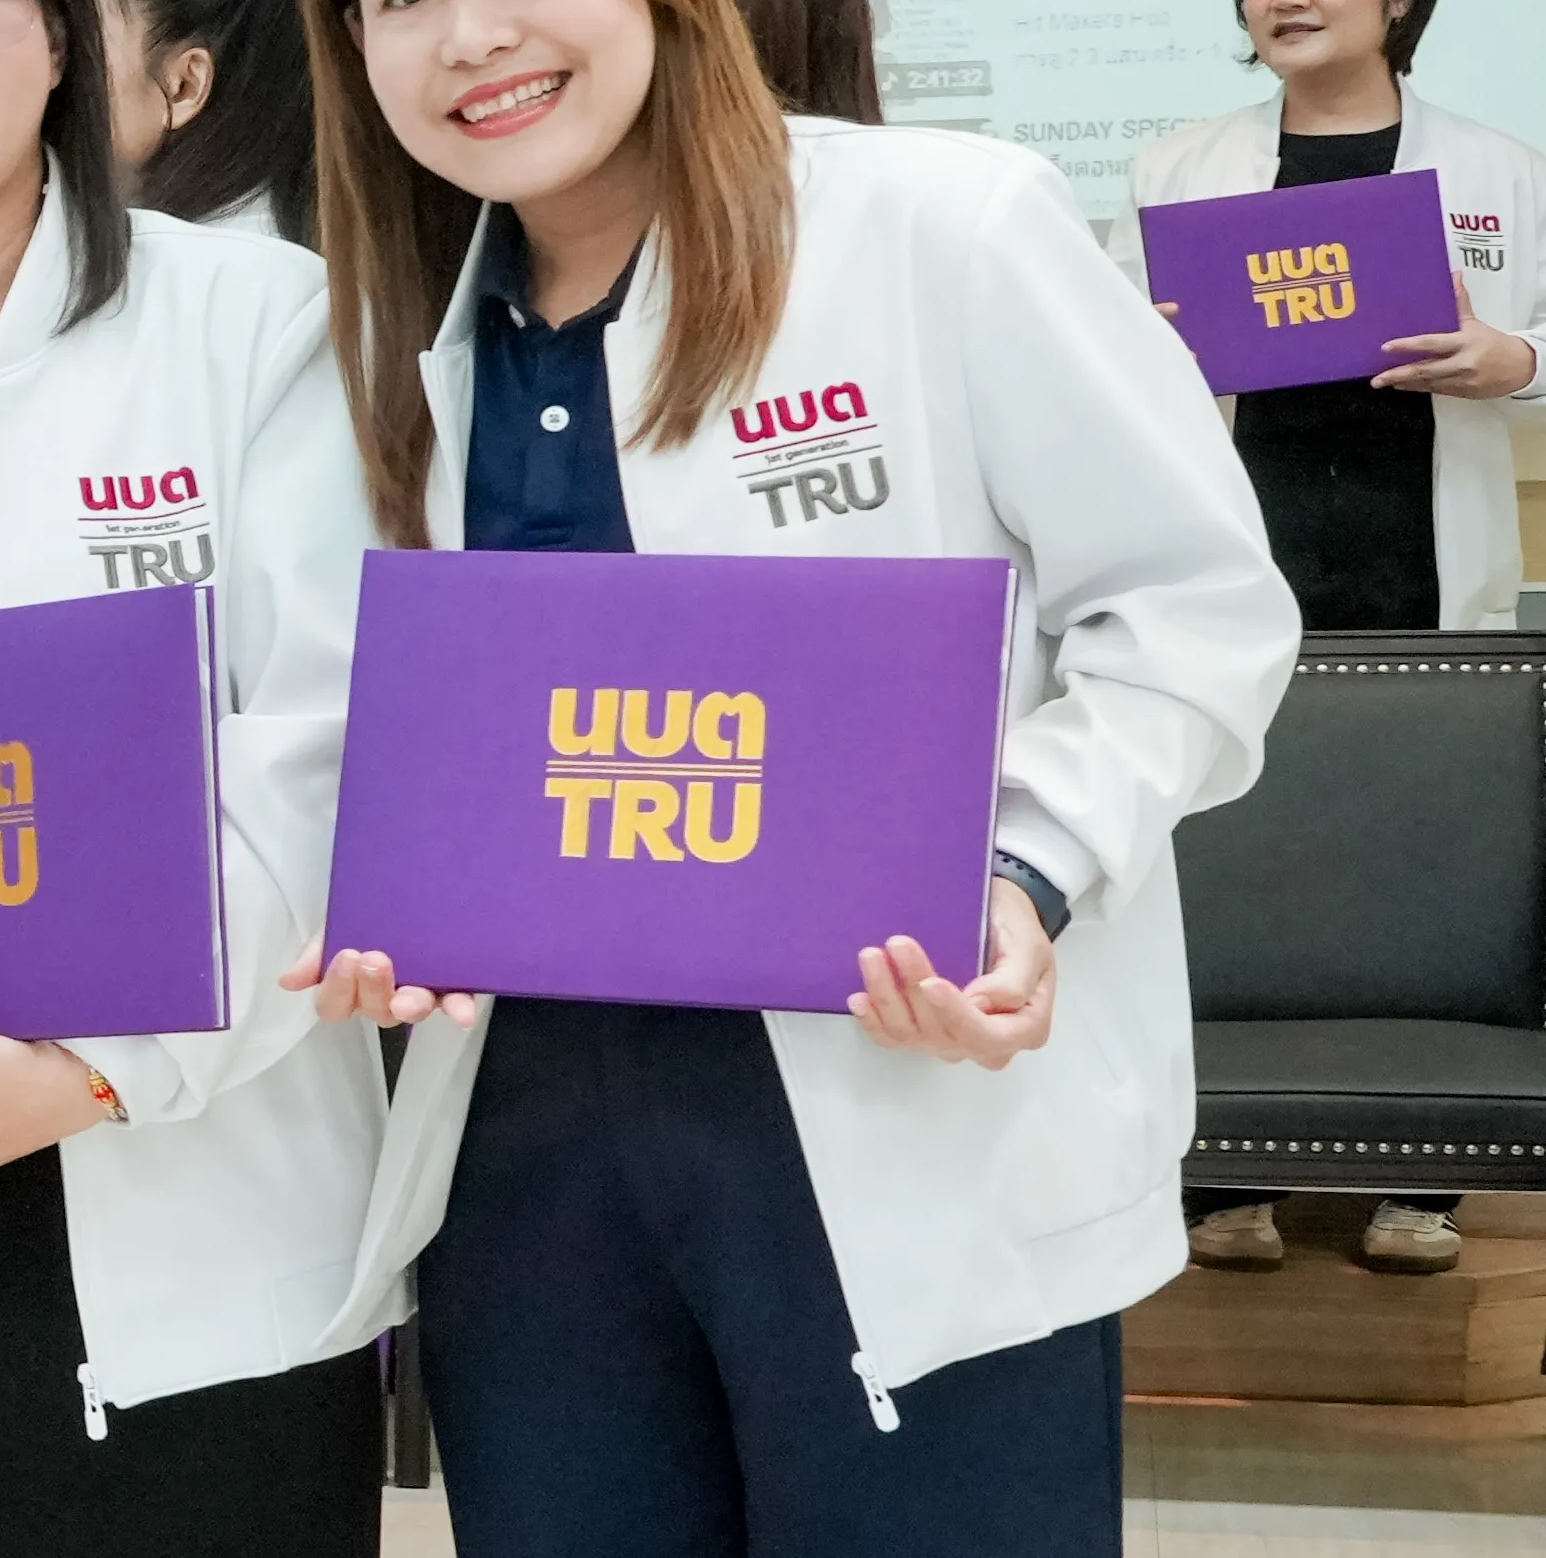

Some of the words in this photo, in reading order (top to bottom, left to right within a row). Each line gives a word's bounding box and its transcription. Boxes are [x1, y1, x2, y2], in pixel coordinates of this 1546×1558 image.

[907, 67, 985, 90] 2:41:32
[1012, 120, 1115, 143] SUNDAY
[1457, 245, 1505, 272] TRU
[1252, 280, 1357, 329] TRU
[747, 455, 891, 529] TRU
[87, 533, 216, 590] TRU
[544, 776, 763, 864] TRU
